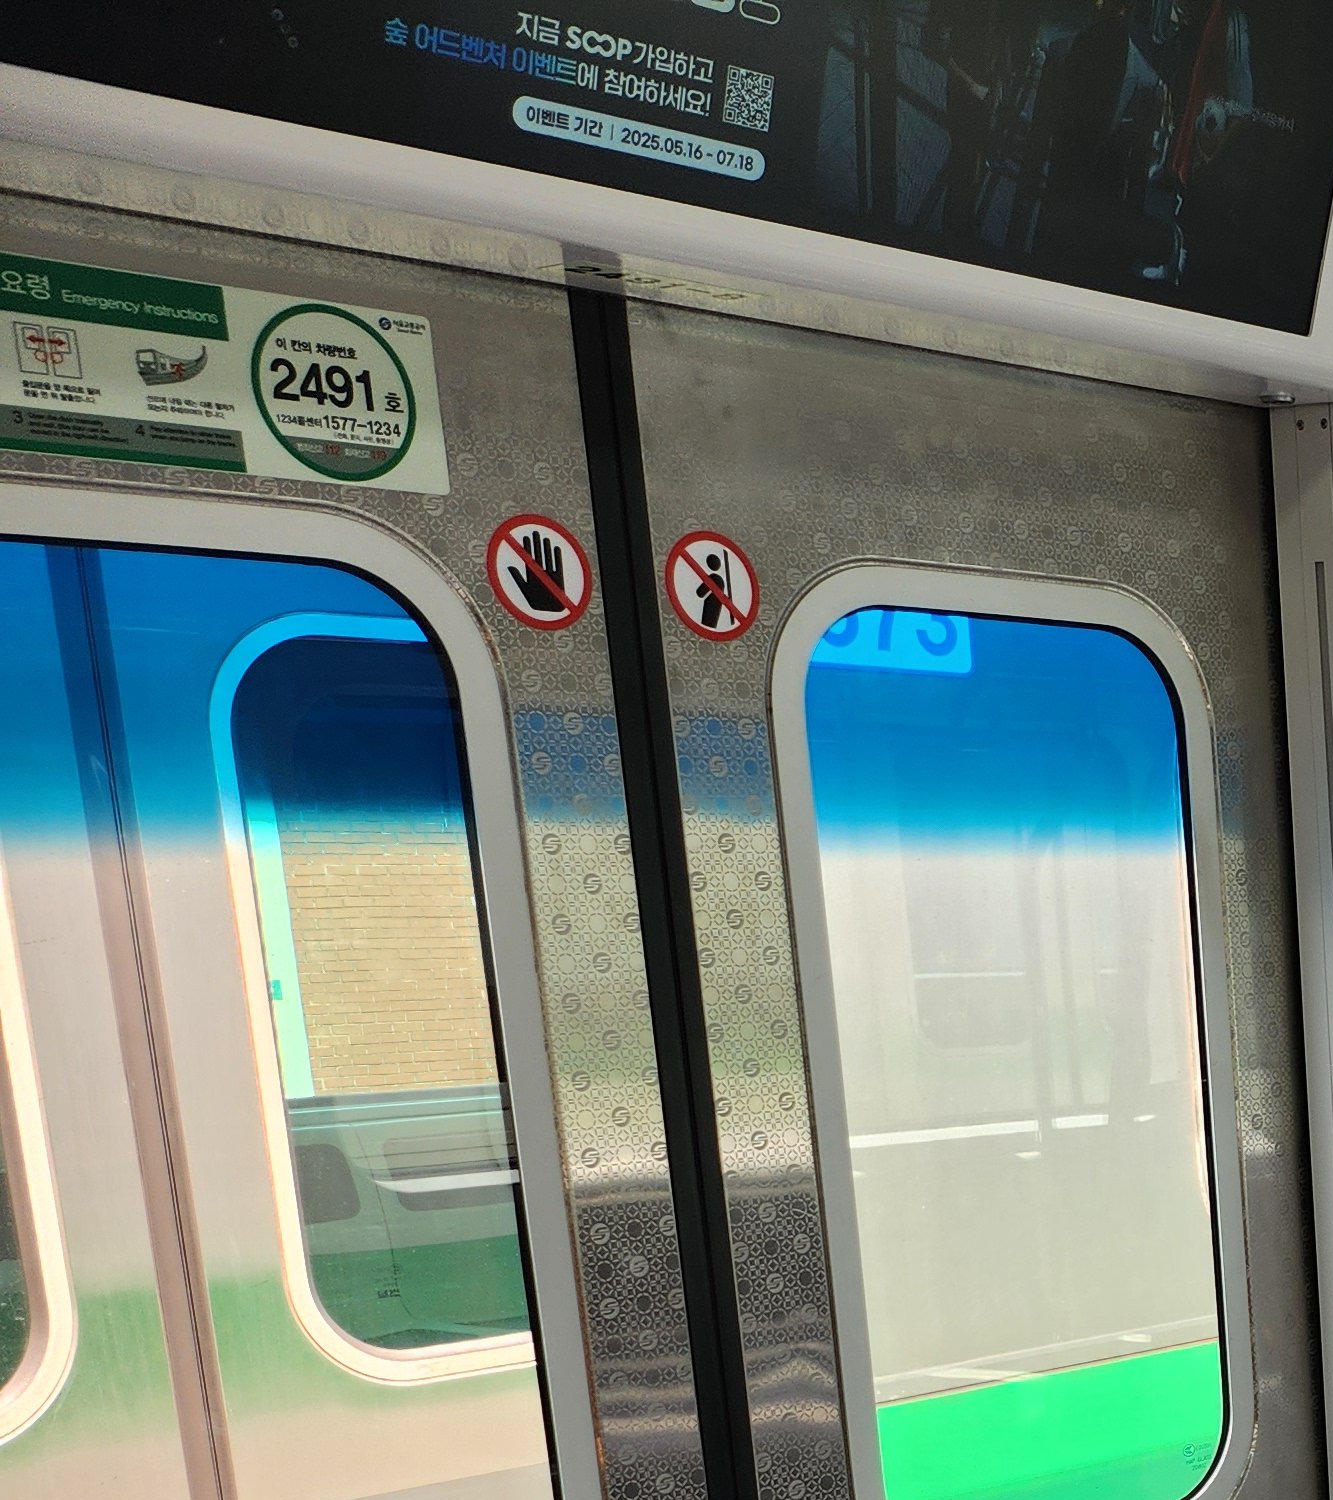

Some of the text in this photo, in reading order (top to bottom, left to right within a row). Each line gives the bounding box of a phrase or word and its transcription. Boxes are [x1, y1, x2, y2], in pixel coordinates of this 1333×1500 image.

[515, 11, 561, 45] 지금
[384, 18, 711, 117] 숲 어드벤처 이벤트에 참여하세요!
[526, 106, 570, 131] 이벤트
[574, 115, 603, 139] 기간
[621, 127, 703, 159] 2025.05.16
[716, 150, 754, 172] 07.18
[61, 289, 219, 324] Emergency Instructions
[275, 337, 288, 351] 이
[290, 338, 312, 354] 칸의
[270, 357, 375, 413] 2491
[384, 391, 405, 413] 호
[12, 409, 24, 424] 3
[135, 424, 146, 437] 4
[322, 414, 402, 437] 1577-1234
